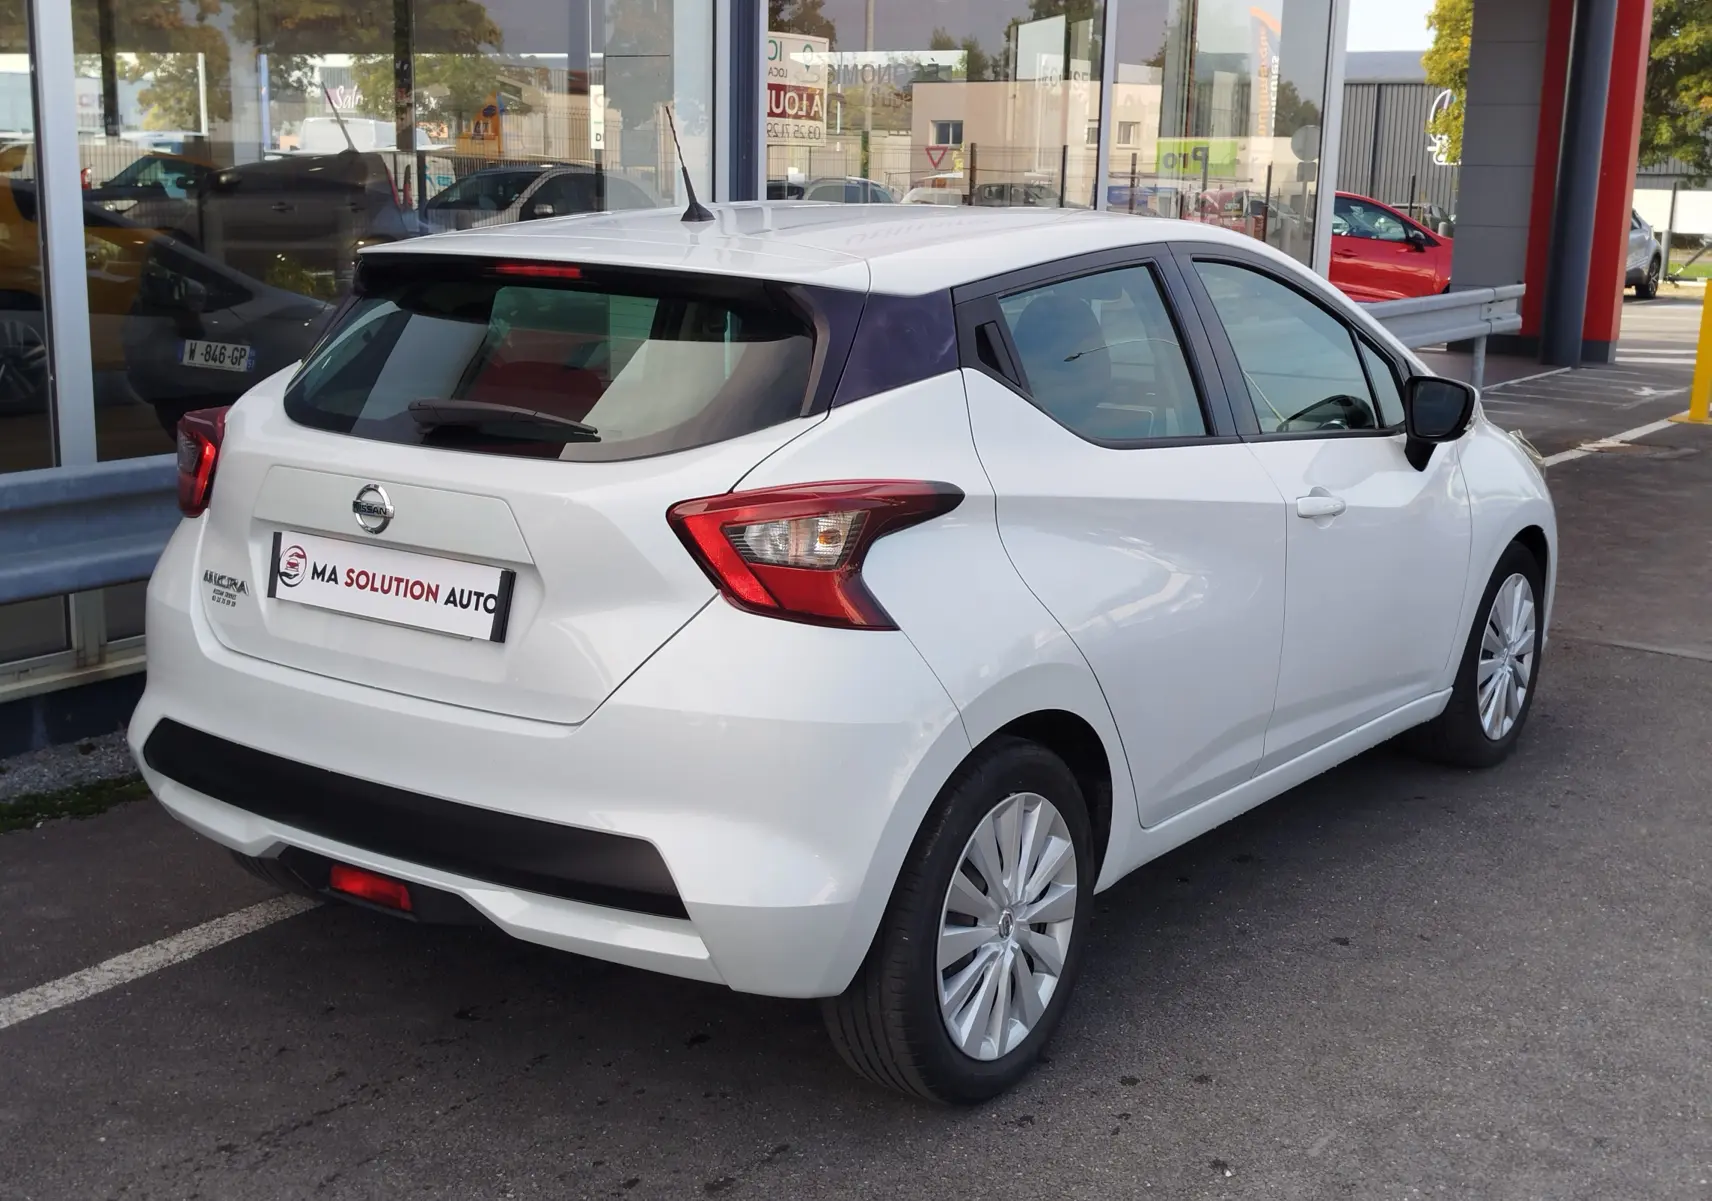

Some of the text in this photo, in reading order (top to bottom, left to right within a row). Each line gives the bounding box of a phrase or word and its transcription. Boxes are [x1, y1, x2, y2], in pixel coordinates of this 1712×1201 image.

[311, 562, 498, 614] MA SOLUTION AUTO
